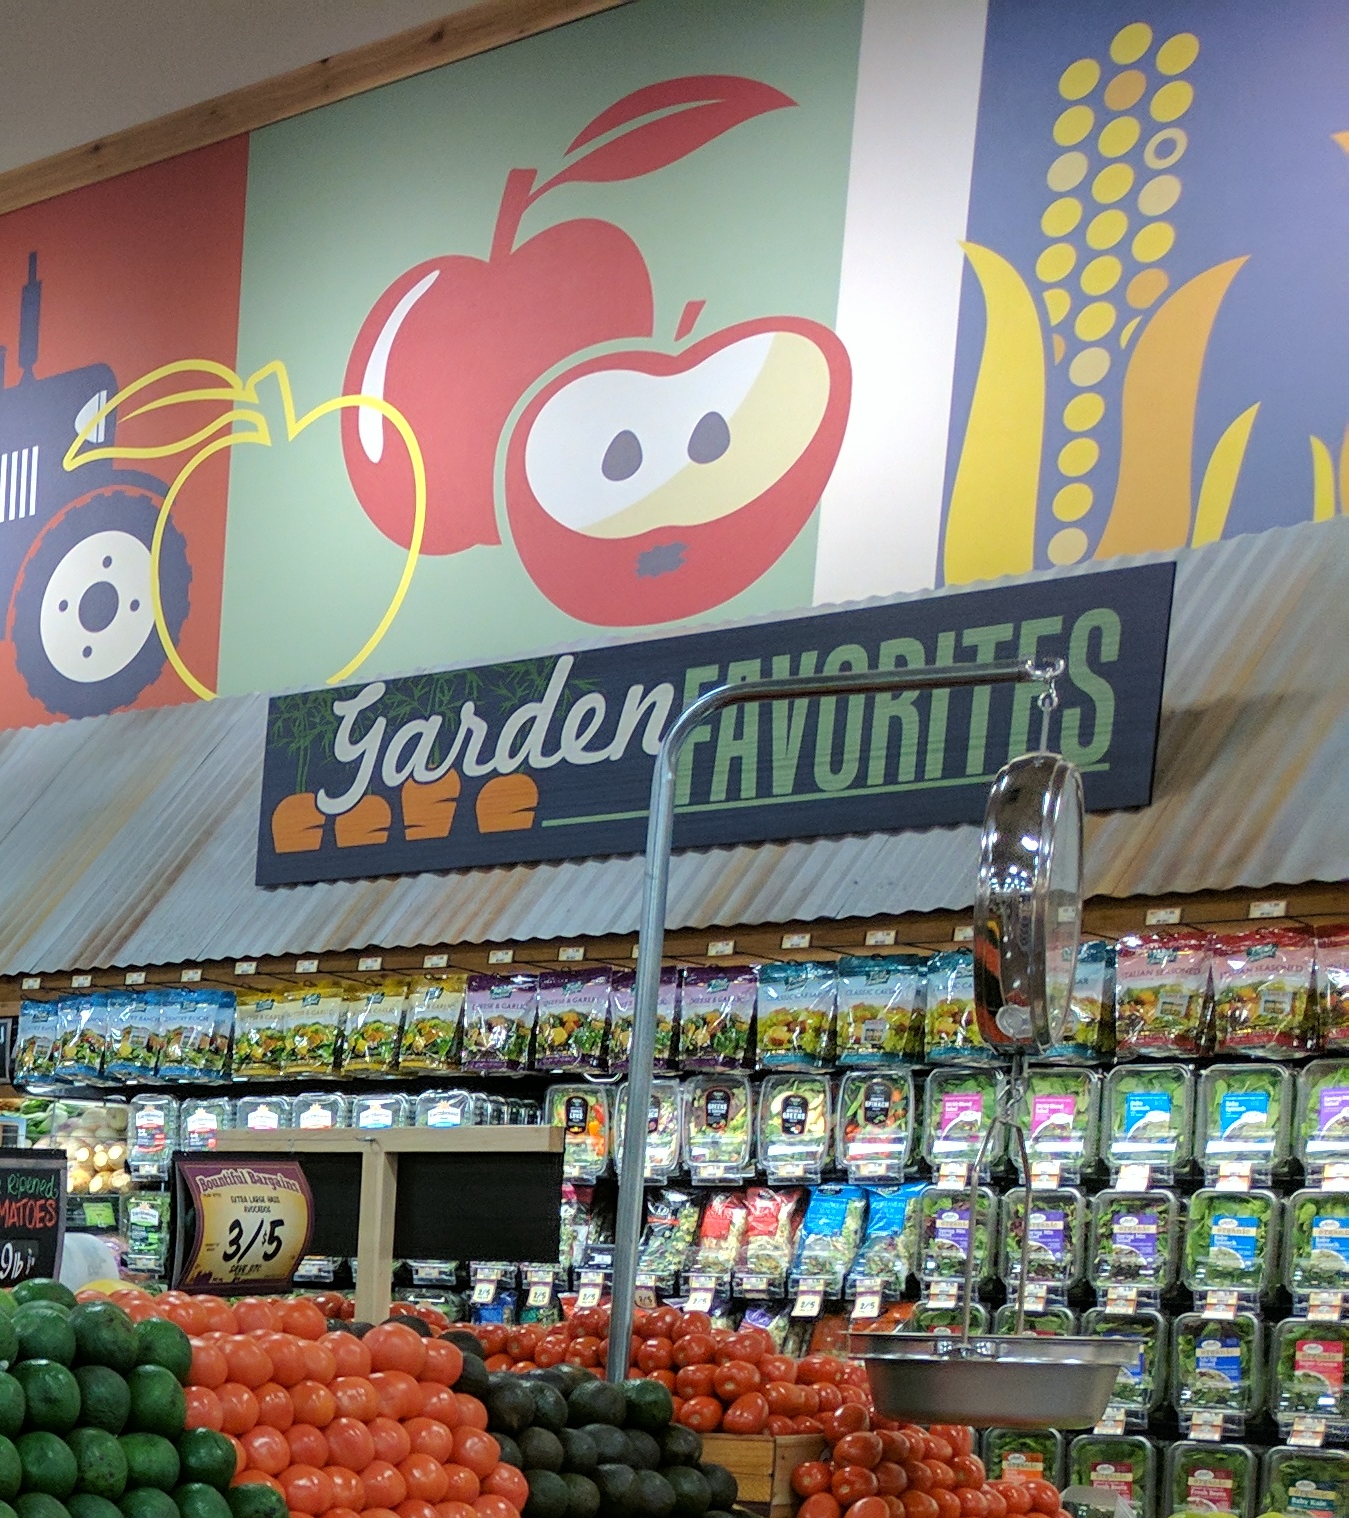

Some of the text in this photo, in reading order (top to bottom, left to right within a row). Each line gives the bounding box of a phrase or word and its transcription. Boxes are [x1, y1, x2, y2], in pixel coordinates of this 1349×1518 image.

[317, 606, 1122, 816] Garden FAVORITES
[197, 1168, 301, 1194] Bountiful Bargains
[222, 1218, 285, 1263] 3/$5
